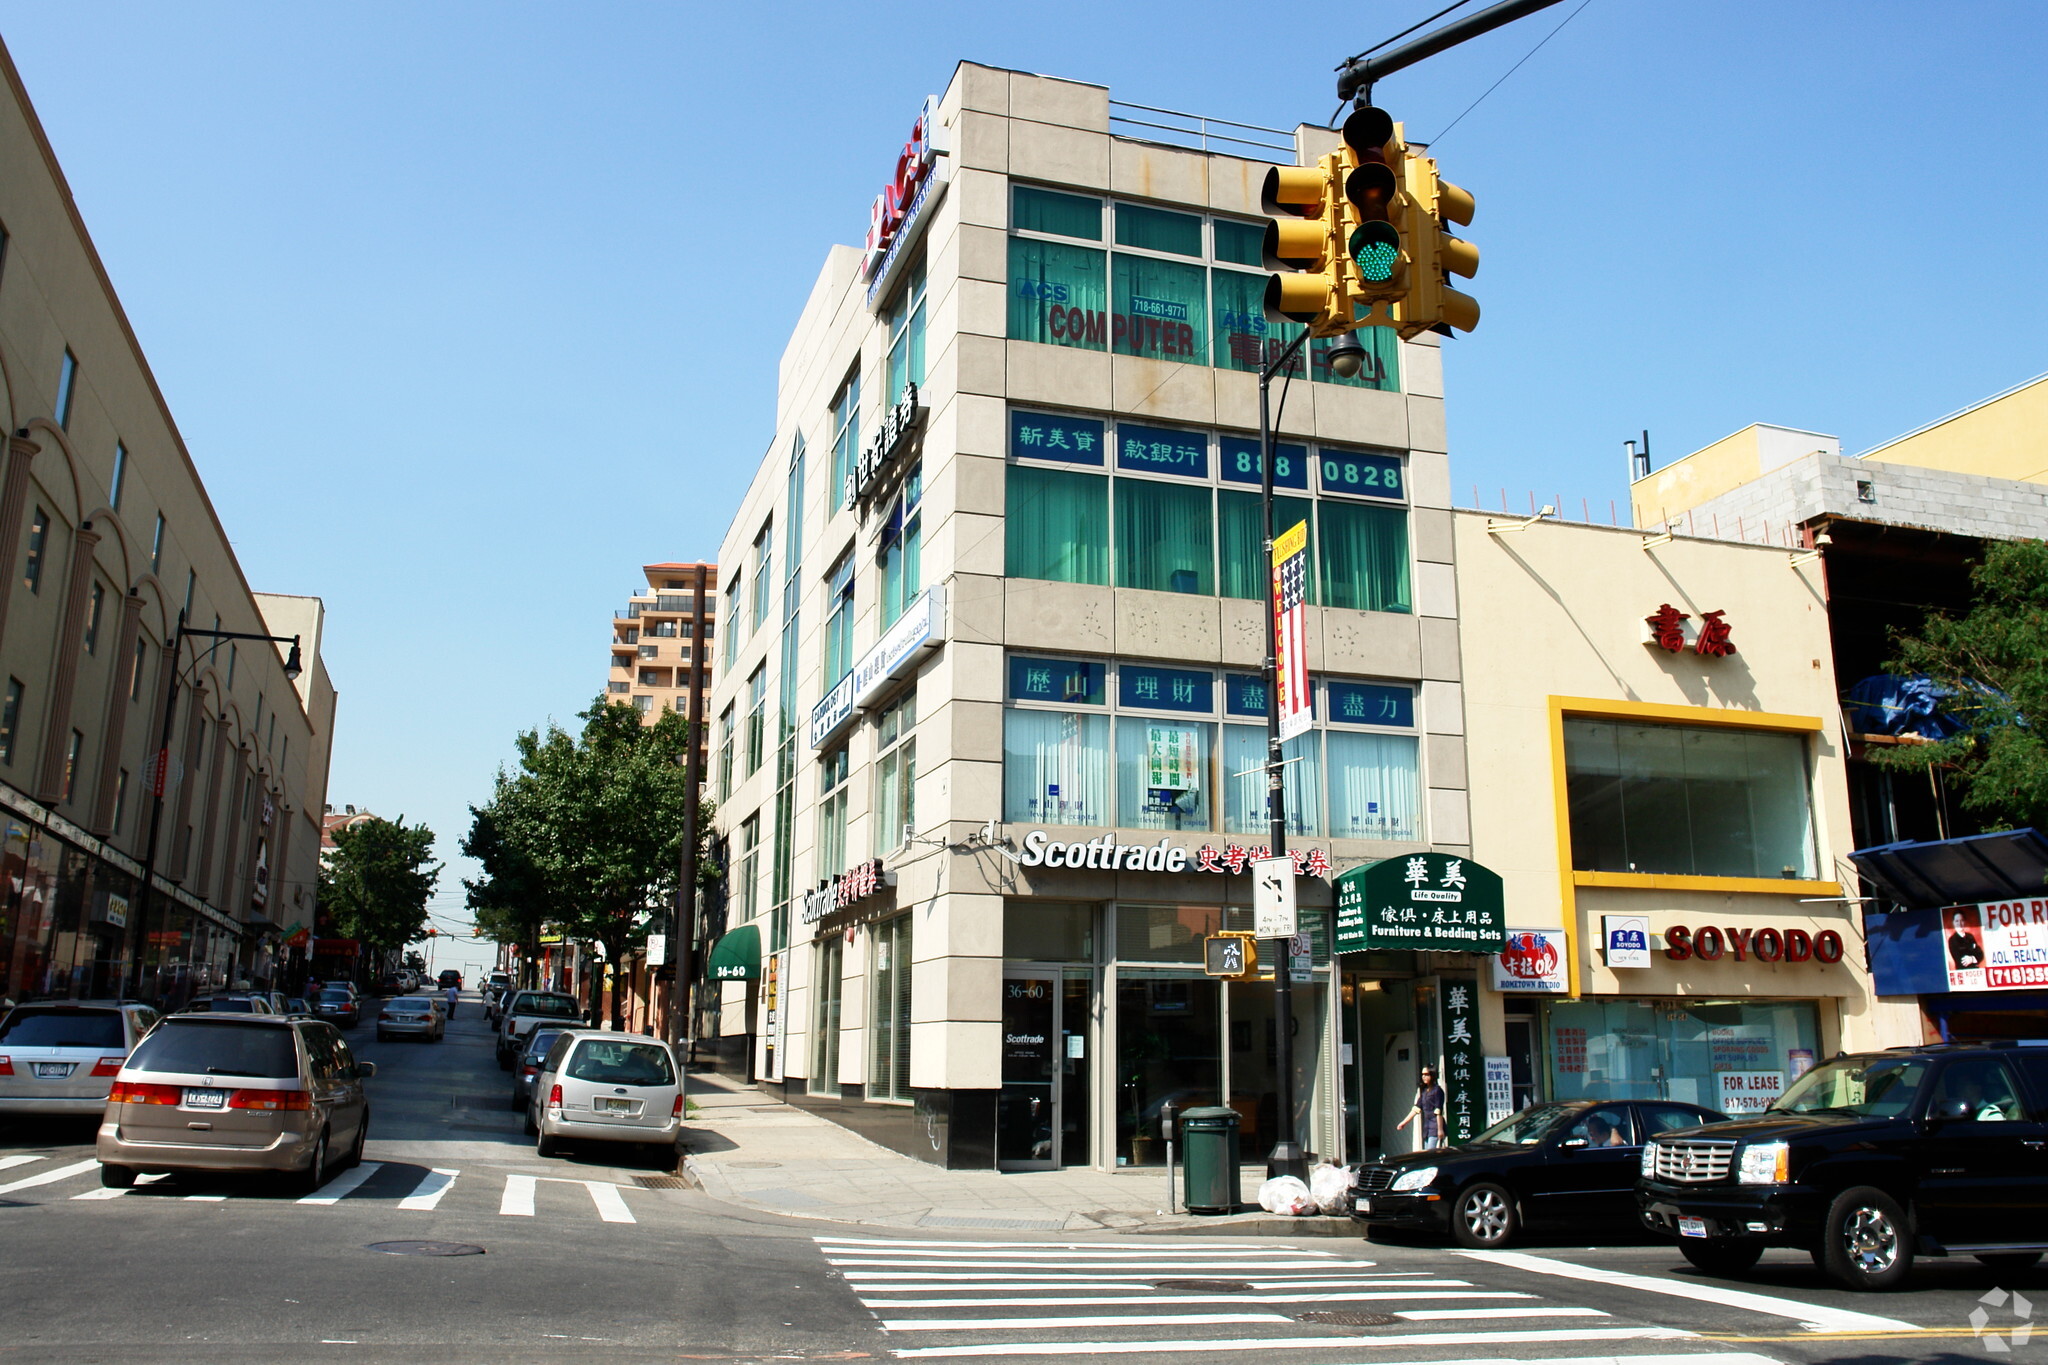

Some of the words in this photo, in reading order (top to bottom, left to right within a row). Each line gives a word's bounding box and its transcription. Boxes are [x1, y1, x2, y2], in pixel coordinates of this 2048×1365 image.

[1020, 281, 1068, 302] ACS
[1134, 299, 1186, 318] 718-661-9771
[1049, 304, 1194, 357] COMPUTER
[1222, 312, 1267, 332] ACS
[1323, 461, 1398, 488] 0828
[1274, 580, 1286, 702] WELCOME
[1021, 830, 1187, 873] Scottrade
[1404, 856, 1467, 890] 華美
[802, 872, 838, 924] Scottrade
[1414, 892, 1429, 900] Life
[1430, 892, 1459, 901] Quality
[1986, 902, 2027, 929] FOR
[1371, 924, 1422, 938] Furniture
[1423, 926, 1433, 938] &
[1434, 927, 1478, 941] Bedding
[1479, 929, 1502, 941] Sets
[1664, 925, 1844, 964] SOYODO
[717, 966, 746, 977] 36-60
[1008, 984, 1044, 998] 36-60
[1500, 980, 1536, 989] HOMETOWN
[1537, 980, 1561, 989] STUDIO
[1006, 1033, 1045, 1044] Scottrade
[1723, 1076, 1744, 1090] FOR
[1748, 1076, 1780, 1090] LEASE
